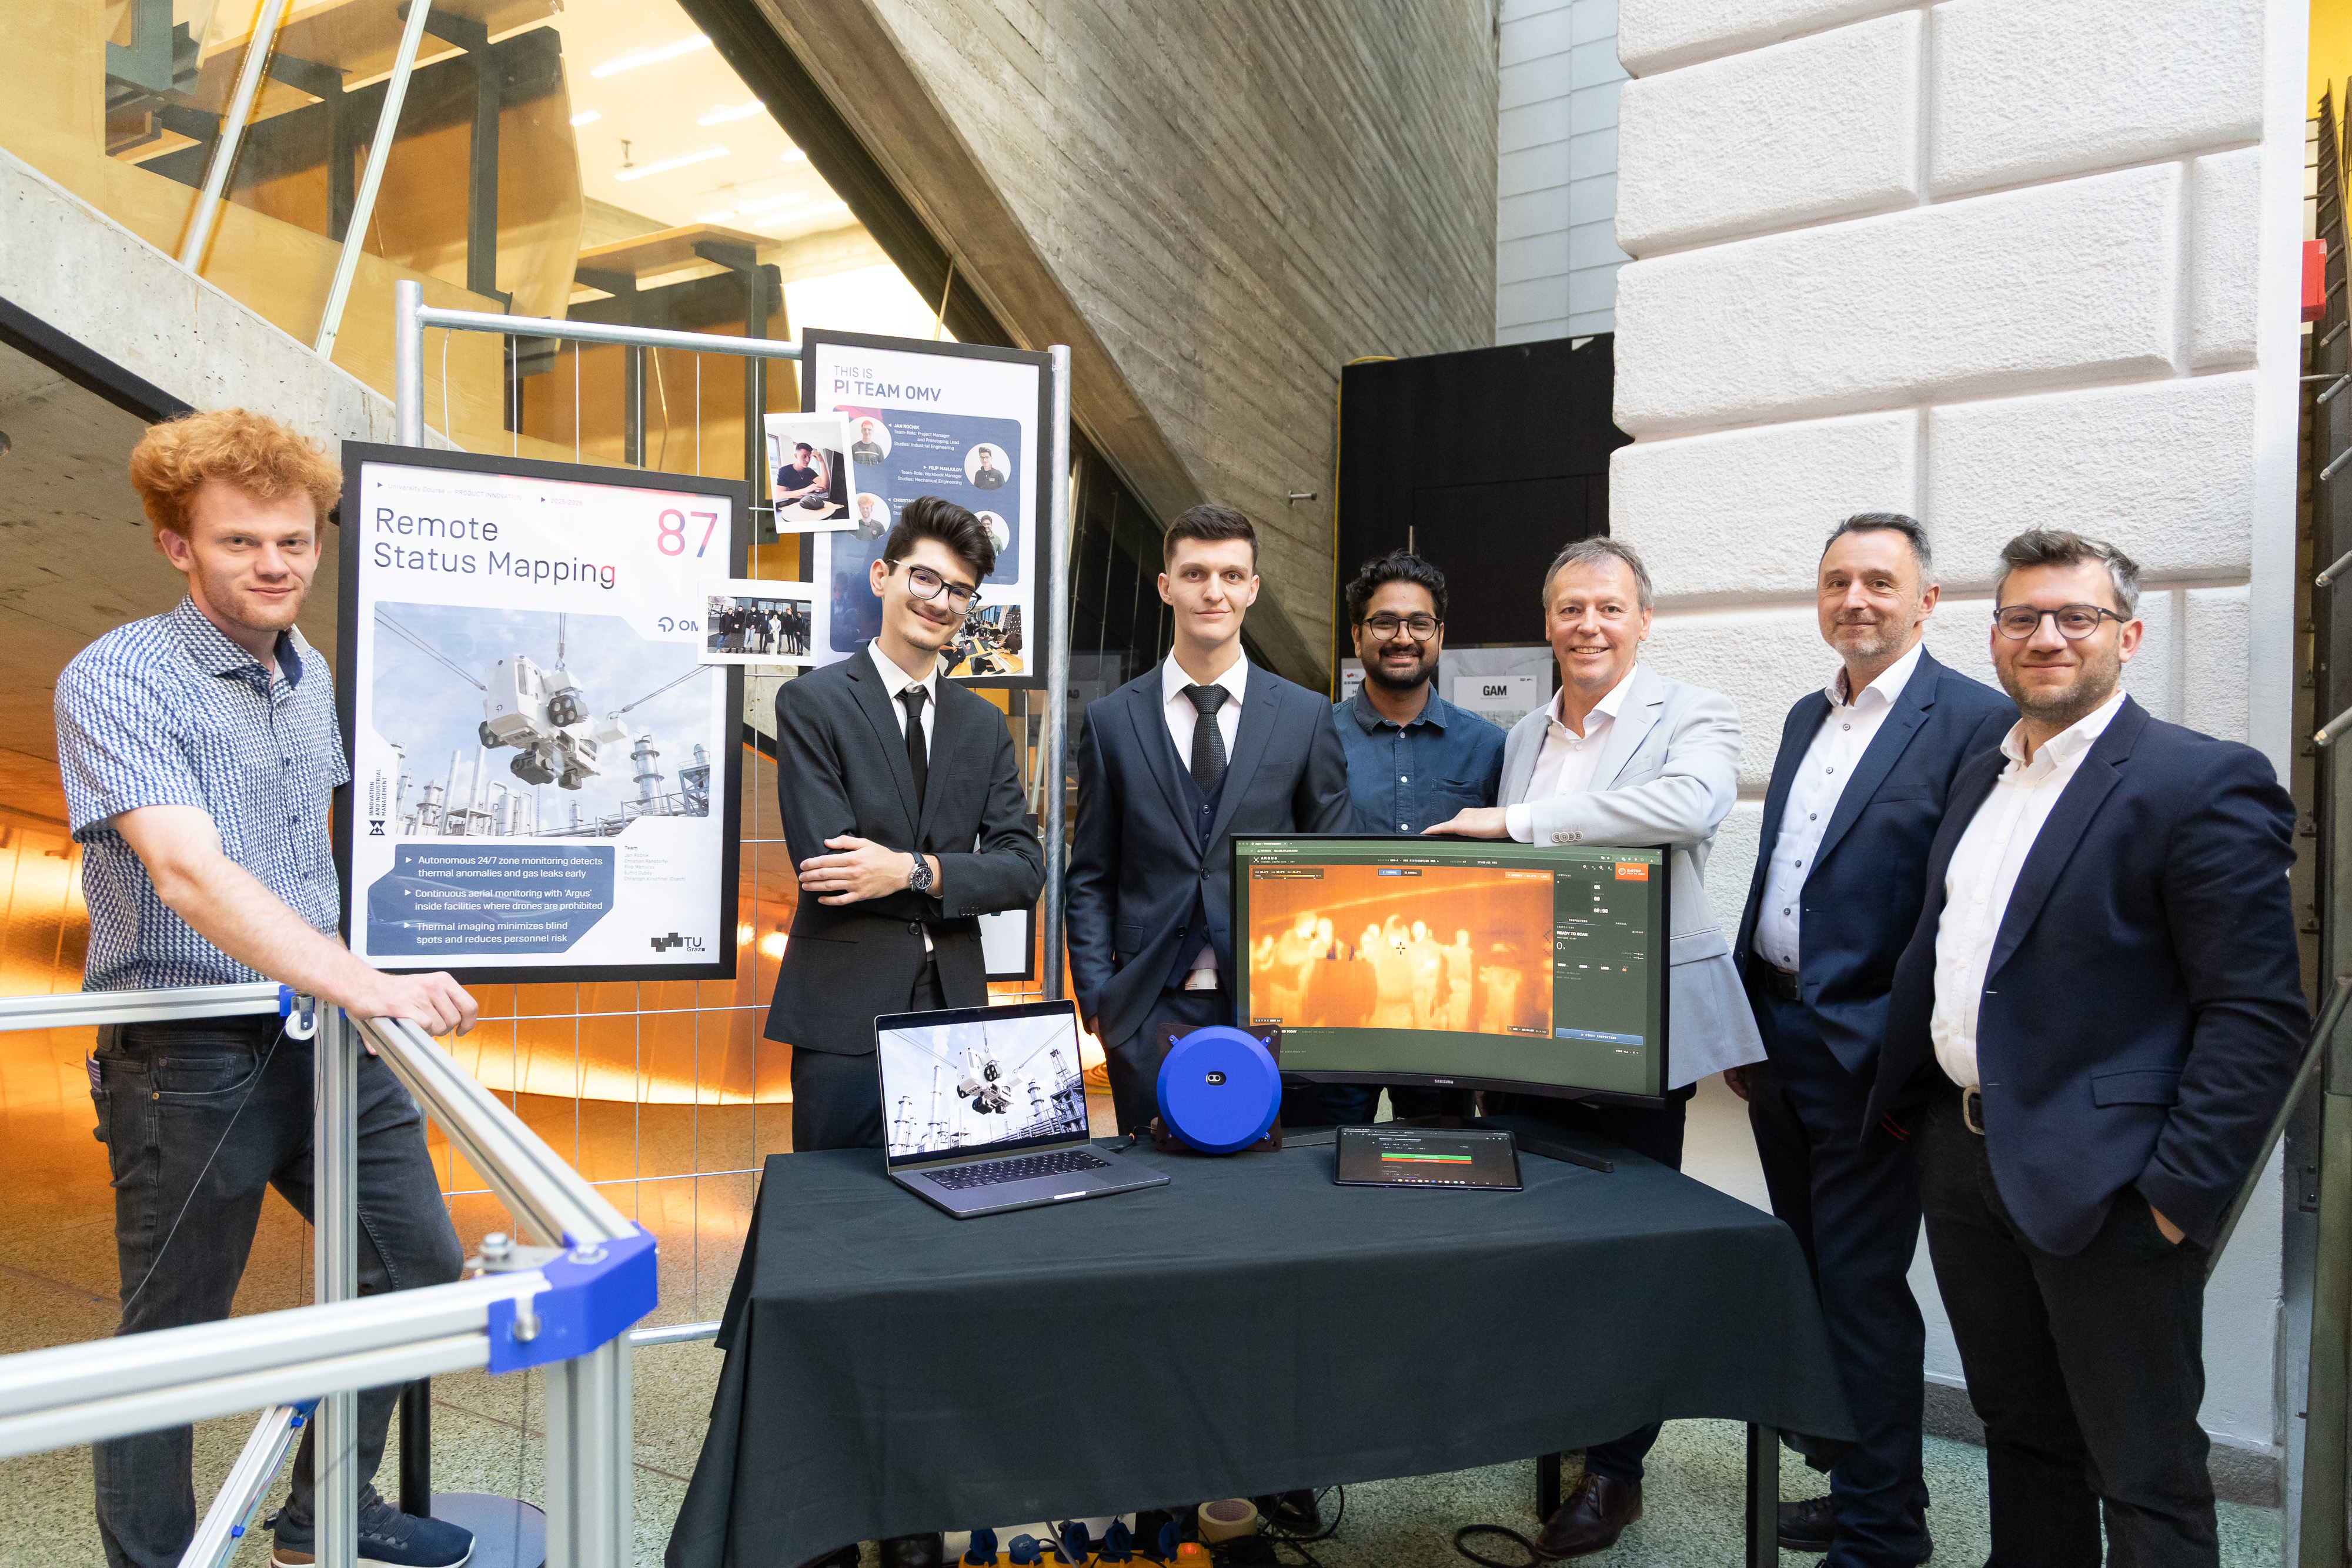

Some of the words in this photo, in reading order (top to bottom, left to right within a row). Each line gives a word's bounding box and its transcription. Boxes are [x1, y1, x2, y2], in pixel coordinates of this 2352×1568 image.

[834, 366, 859, 377] THIS
[863, 368, 873, 379] IS
[834, 379, 849, 394] PI
[854, 382, 900, 398] TEAM
[906, 386, 941, 402] OMV
[388, 483, 421, 493] University
[455, 489, 484, 497] PRODUCT
[550, 498, 583, 507] 2025/2026
[376, 507, 498, 541] Remote
[657, 509, 718, 558] 87
[374, 542, 477, 574] Status
[489, 551, 616, 590] Mapping
[679, 620, 699, 631] OM
[1483, 685, 1507, 696] GAM
[418, 856, 476, 865] Autonomous
[477, 857, 497, 865] 24/7
[522, 857, 569, 867] monitoring
[570, 857, 603, 865] detects
[418, 869, 454, 877] thermal
[522, 871, 539, 879] gas
[565, 870, 586, 879] early
[415, 889, 466, 898] Continuous
[468, 890, 493, 898] aerial
[495, 890, 542, 899] monitoring
[415, 902, 442, 911] inside
[443, 902, 481, 910] facilities
[483, 902, 510, 910] where
[512, 902, 542, 910] drones
[559, 902, 603, 911] prohibited
[416, 922, 455, 931] Thermal
[457, 922, 495, 932] imaging
[497, 922, 544, 930] minimizes
[546, 921, 568, 930] blind
[416, 935, 443, 945] spots
[445, 935, 463, 944] and
[465, 935, 501, 943] reduces
[503, 934, 549, 944] personnel
[551, 934, 567, 942] risk
[684, 937, 702, 947] TU
